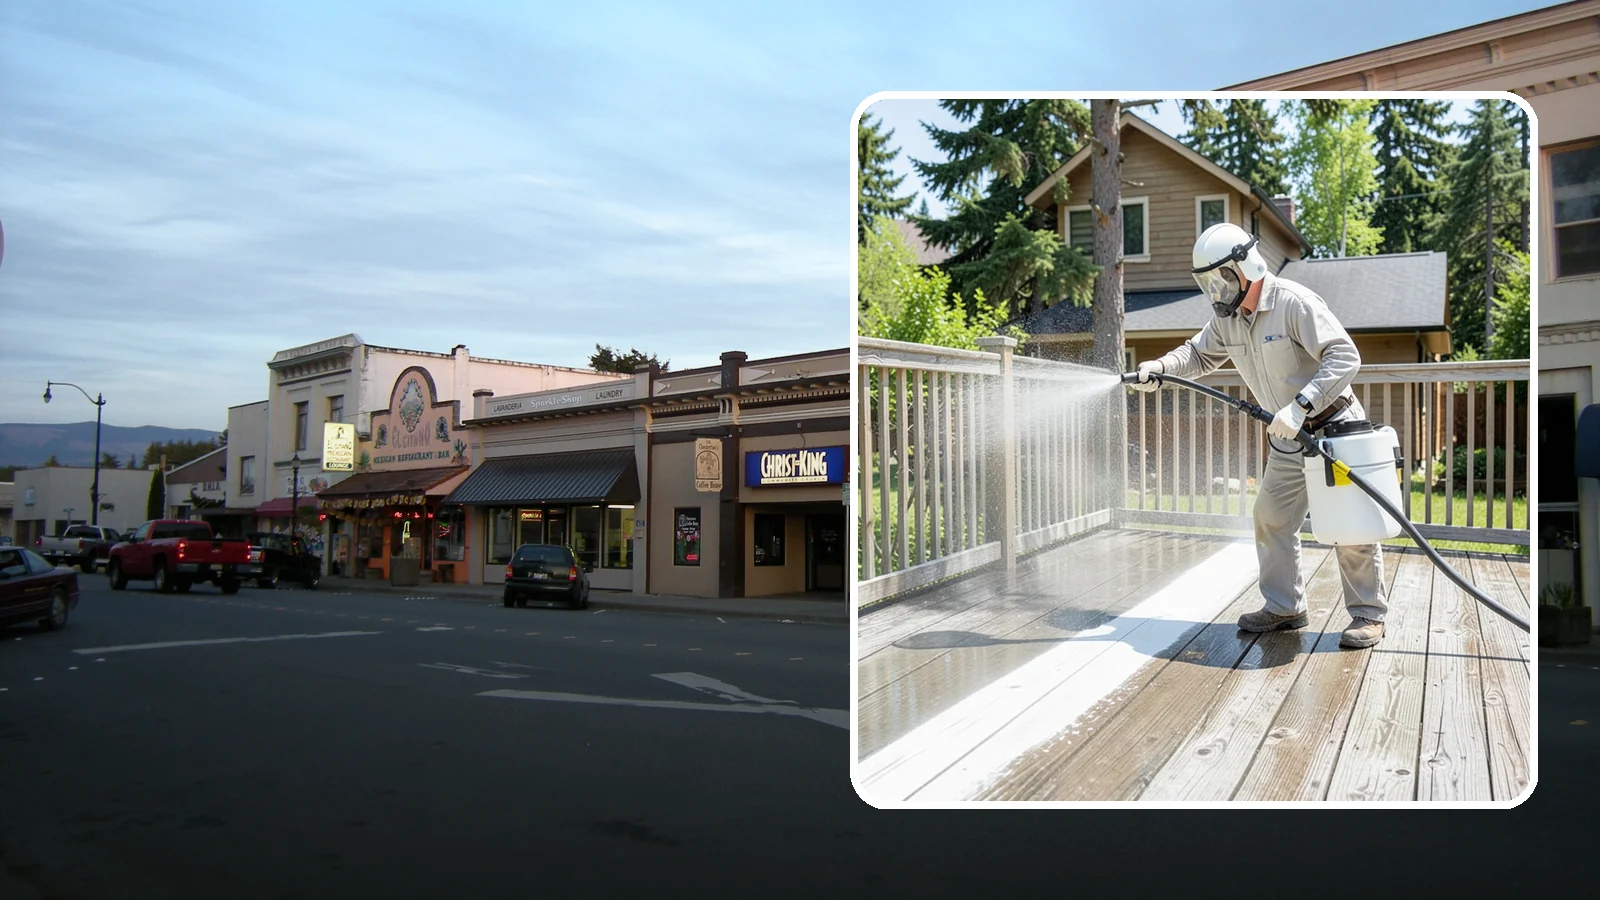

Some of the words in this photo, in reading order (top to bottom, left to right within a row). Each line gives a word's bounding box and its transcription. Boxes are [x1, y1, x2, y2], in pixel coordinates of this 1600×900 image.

[596, 389, 624, 400] LAUNDRY
[493, 402, 523, 412] LAVANDERIA
[373, 454, 396, 464] MEXICAN
[397, 451, 433, 462] RESTAURANT
[438, 450, 450, 459] BAR
[761, 451, 796, 478] CHRIST
[798, 450, 828, 476] KING
